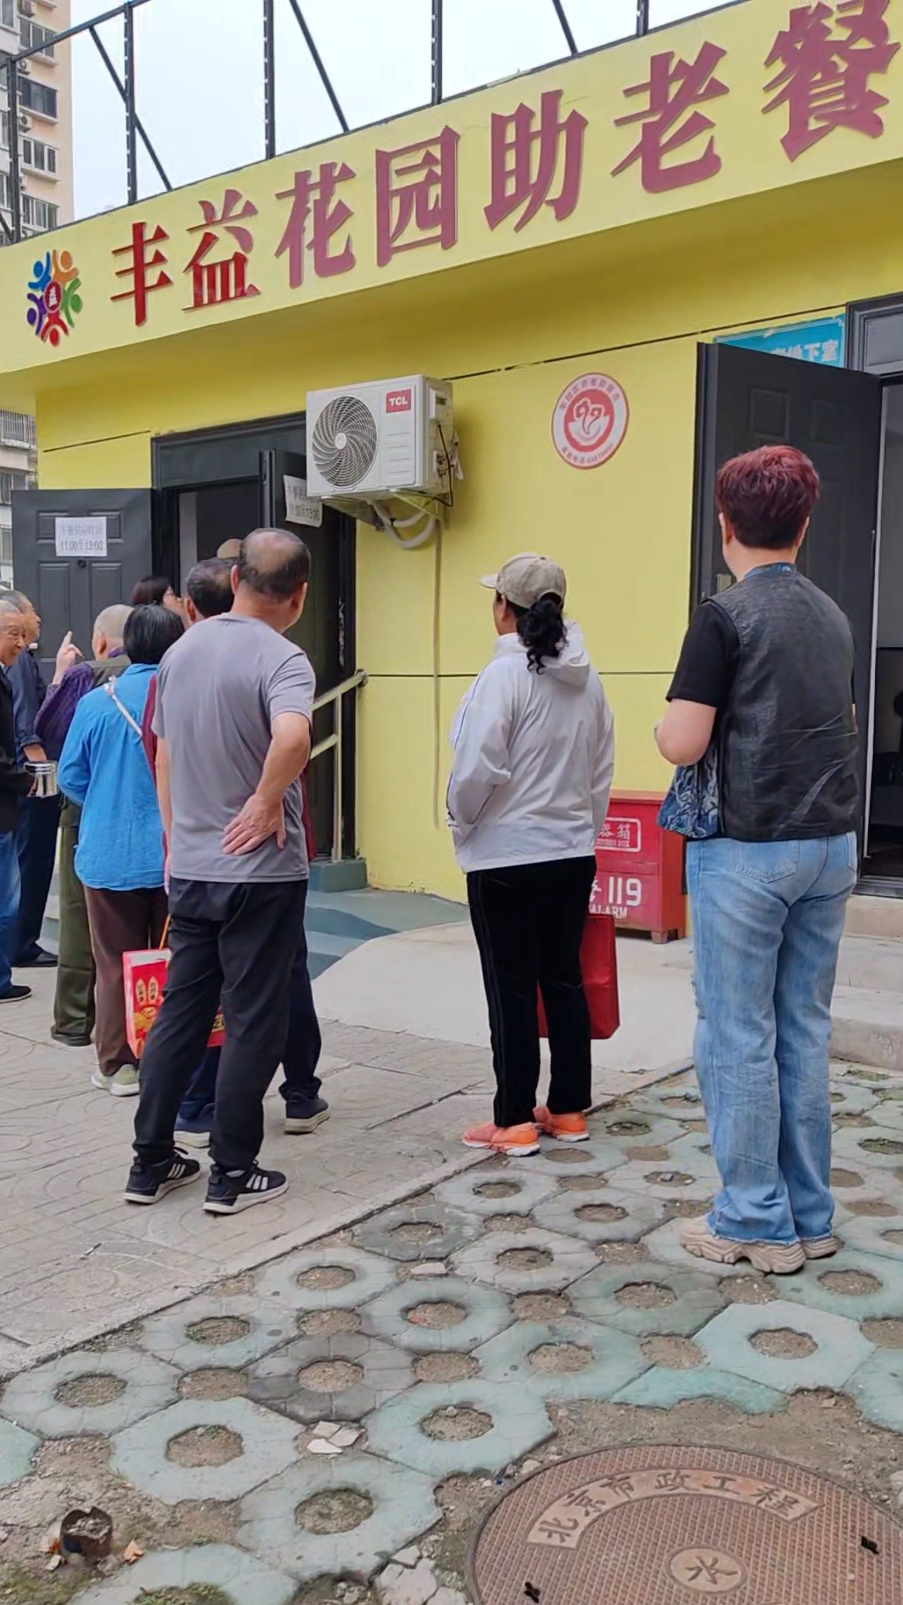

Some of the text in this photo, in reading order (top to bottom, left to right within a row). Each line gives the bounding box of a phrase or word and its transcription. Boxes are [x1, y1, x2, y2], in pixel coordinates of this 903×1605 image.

[110, 0, 902, 327] 丰益花园助老餐
[389, 397, 408, 407] TCL
[608, 876, 642, 907] 119
[588, 904, 628, 919] ALARM
[538, 1470, 800, 1544] 北京市政工程
[684, 1556, 739, 1585] 水
